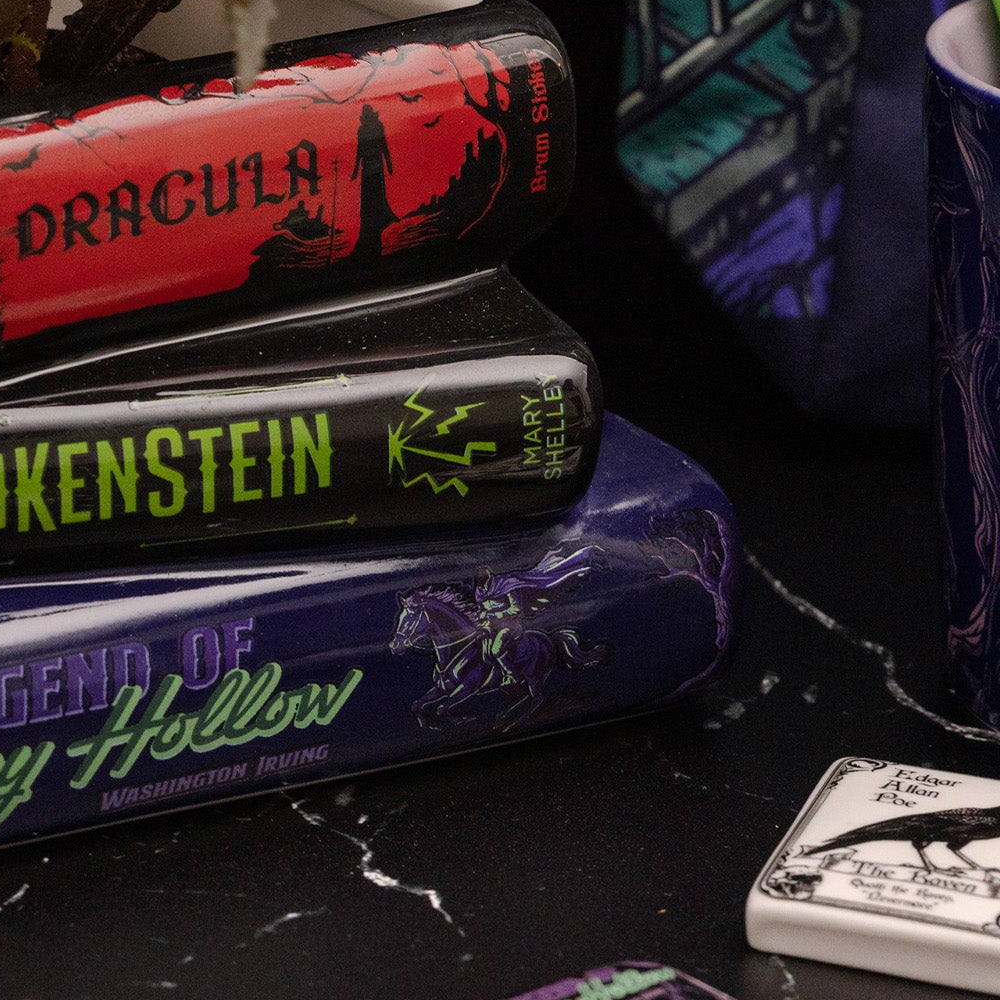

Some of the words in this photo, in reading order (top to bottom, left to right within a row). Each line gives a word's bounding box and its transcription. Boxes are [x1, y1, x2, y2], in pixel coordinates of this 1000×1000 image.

[523, 47, 549, 124] Stoker
[530, 132, 549, 193] Bram
[14, 138, 323, 262] DRACULA
[520, 394, 541, 465] MARY
[540, 372, 565, 480] SHELLEY
[181, 617, 254, 691] OF
[66, 662, 363, 789] Hollow
[101, 762, 248, 811] WASHINGTON
[255, 744, 330, 776] IRVING
[868, 791, 917, 808] Poe
[878, 779, 940, 799] Allan
[888, 768, 962, 788] Edgar
[853, 860, 895, 879] The
[910, 870, 977, 894] Raven
